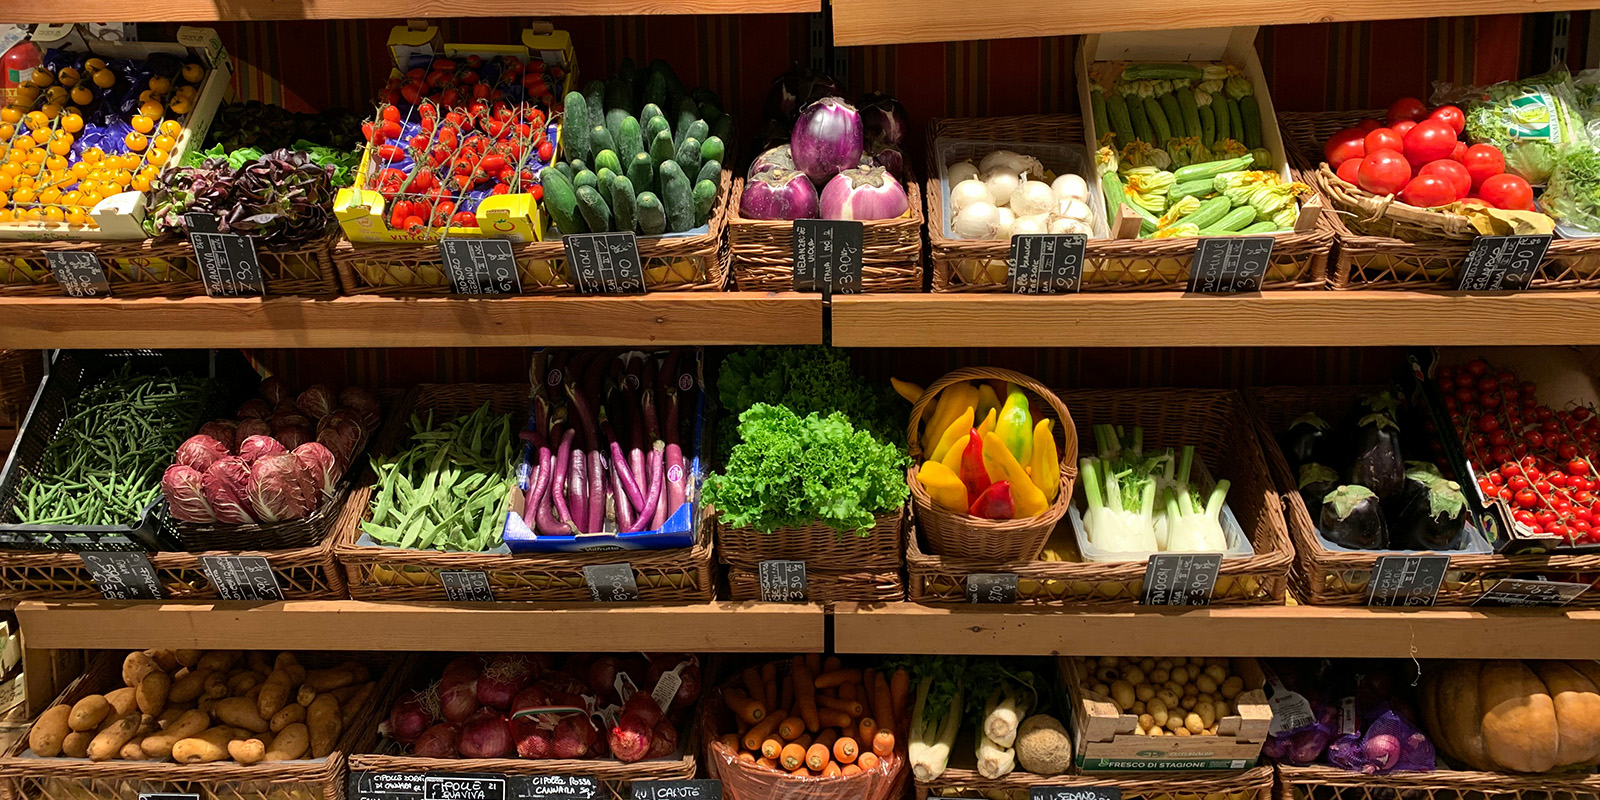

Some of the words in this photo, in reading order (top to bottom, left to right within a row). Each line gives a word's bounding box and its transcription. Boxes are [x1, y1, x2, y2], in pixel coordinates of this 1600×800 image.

[391, 234, 438, 242] VITTORI
[451, 258, 469, 293] OMODORO
[404, 774, 425, 782] DORAT
[535, 786, 575, 794] CANNARA
